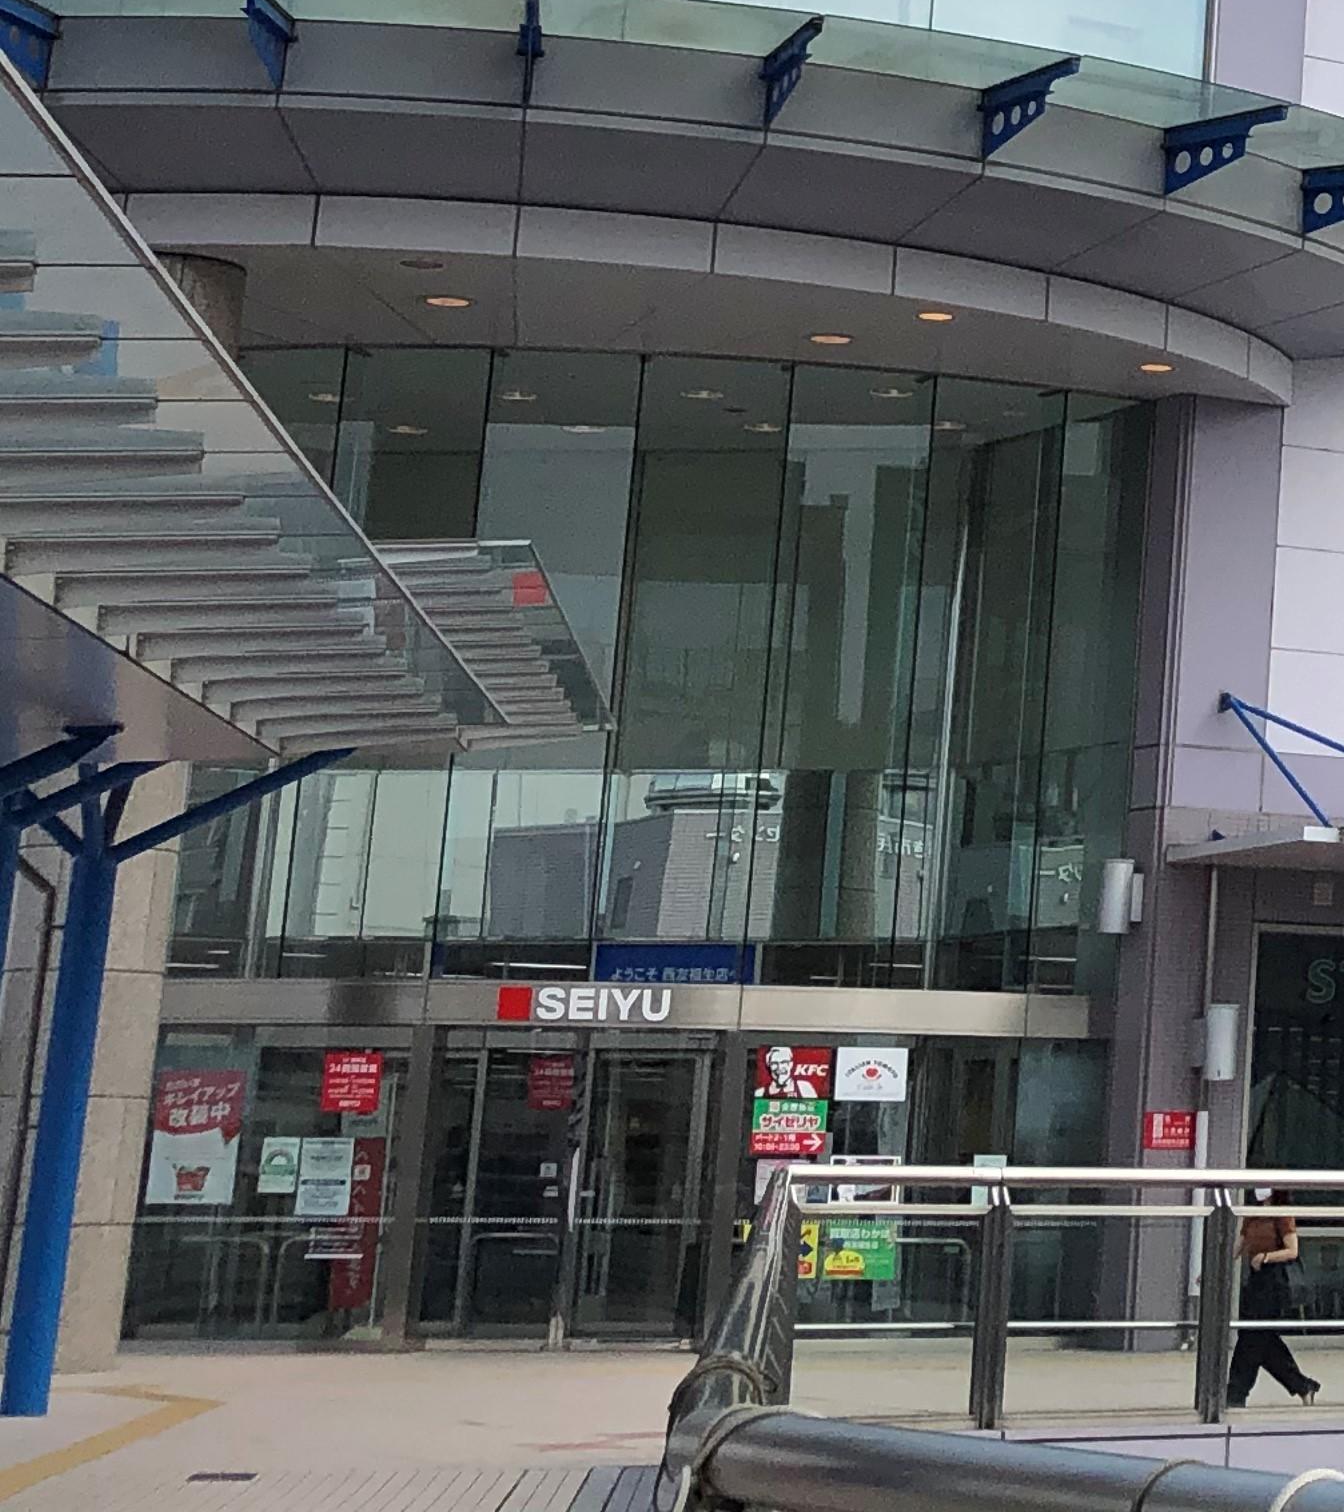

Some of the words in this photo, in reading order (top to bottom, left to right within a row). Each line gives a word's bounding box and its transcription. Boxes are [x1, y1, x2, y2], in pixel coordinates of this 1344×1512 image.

[610, 967, 659, 982] ようこそ
[535, 987, 672, 1022] SEIYU
[794, 1063, 830, 1077] KFC
[162, 1081, 241, 1107] キレイアップ
[760, 1114, 821, 1130] サイゼリヤ
